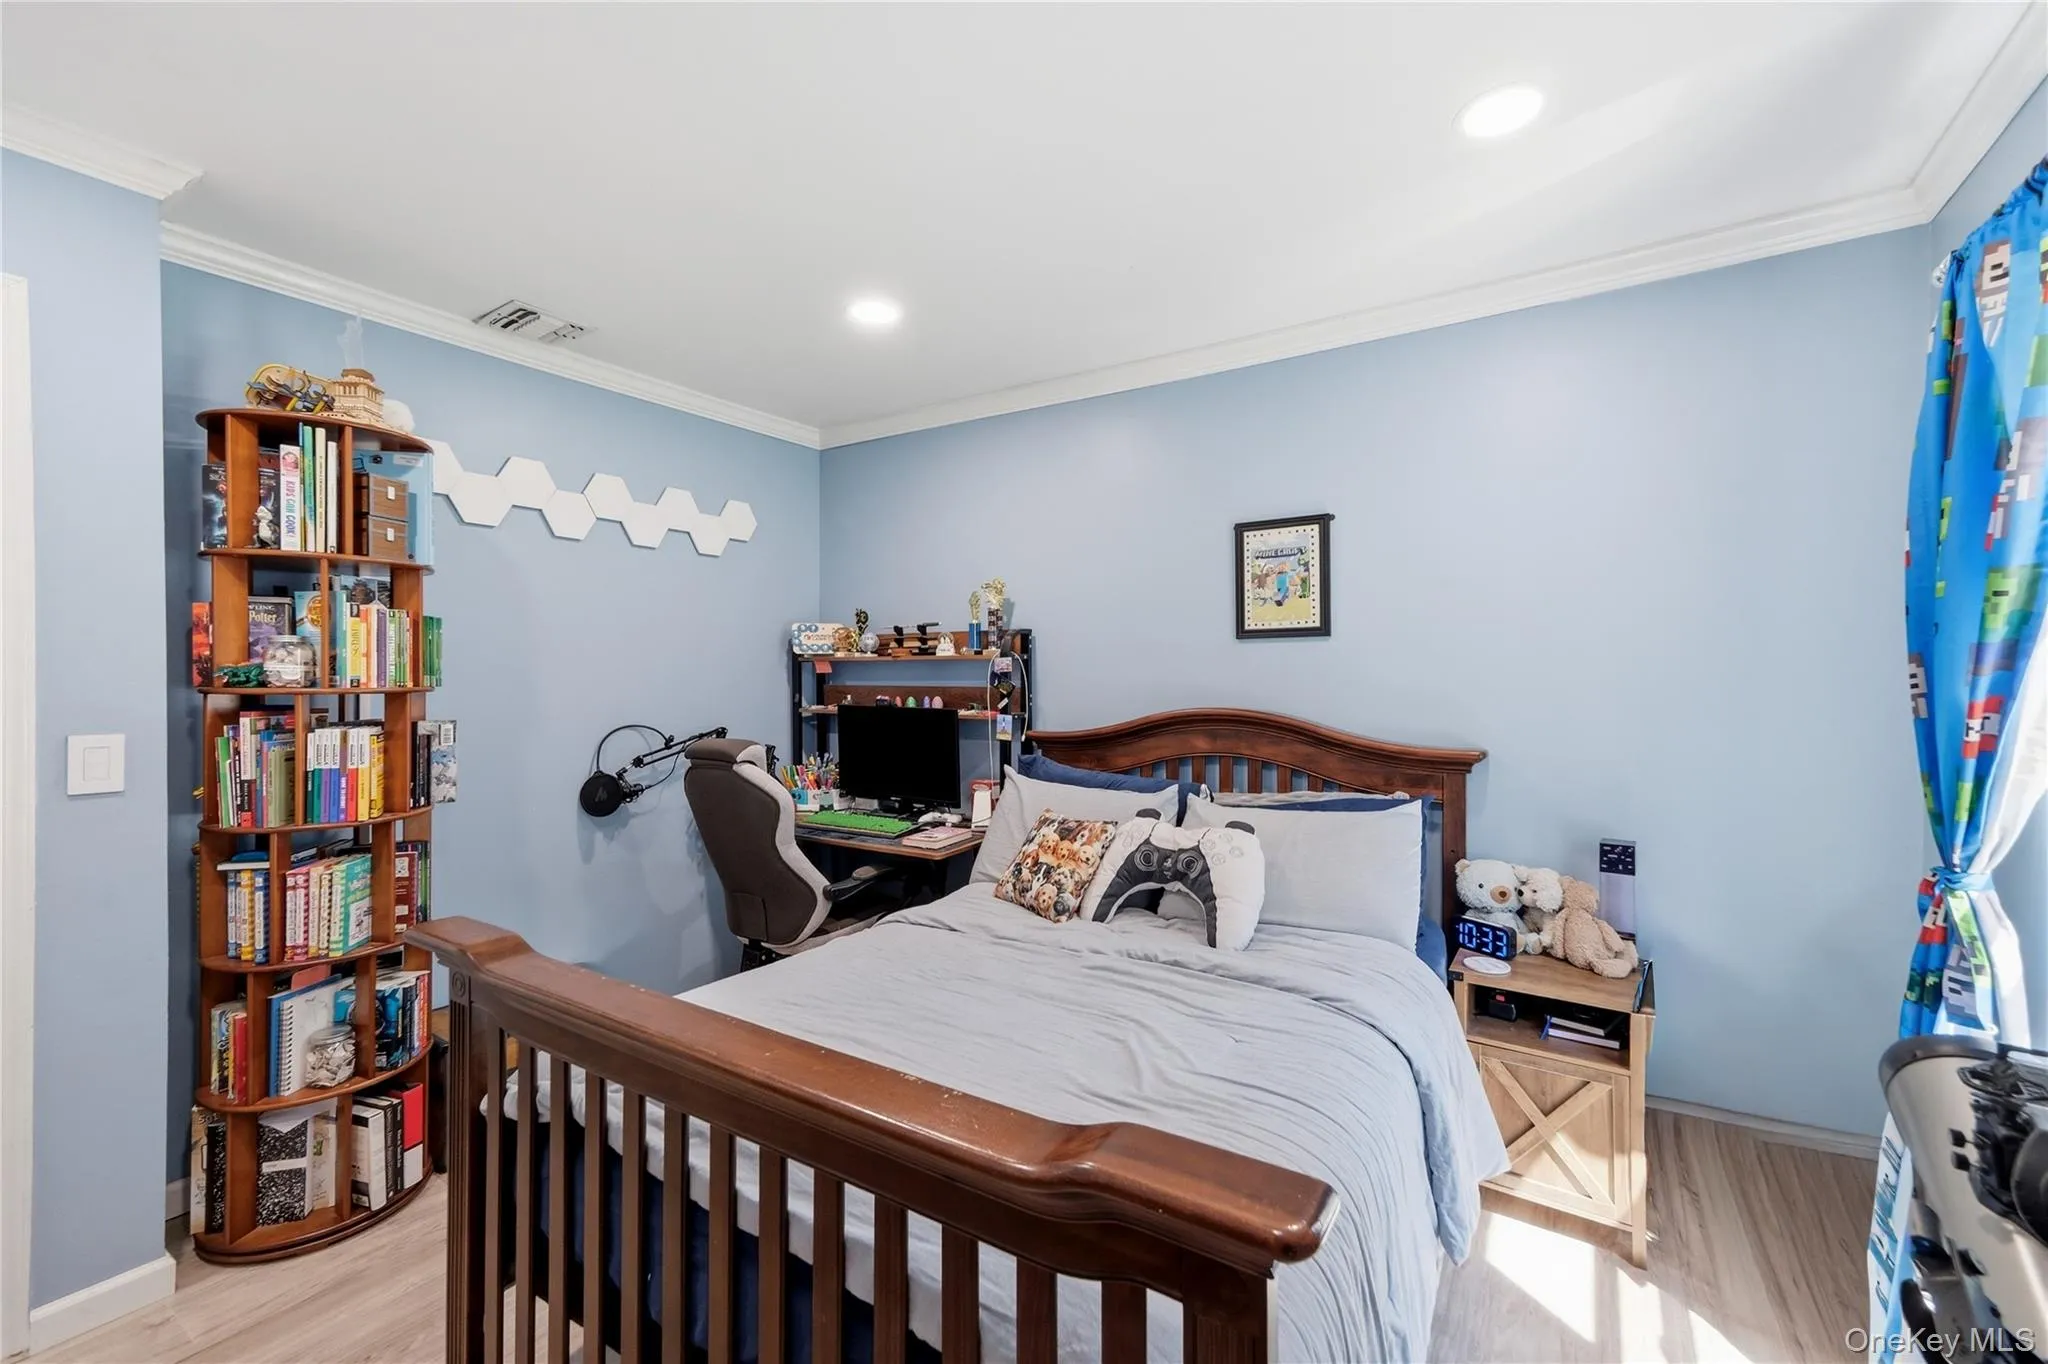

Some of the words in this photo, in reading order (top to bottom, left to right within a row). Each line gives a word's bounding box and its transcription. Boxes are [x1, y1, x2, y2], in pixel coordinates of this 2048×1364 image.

[286, 480, 297, 497] KIDS
[248, 610, 278, 624] Potter
[1456, 922, 1507, 957] 10:33
